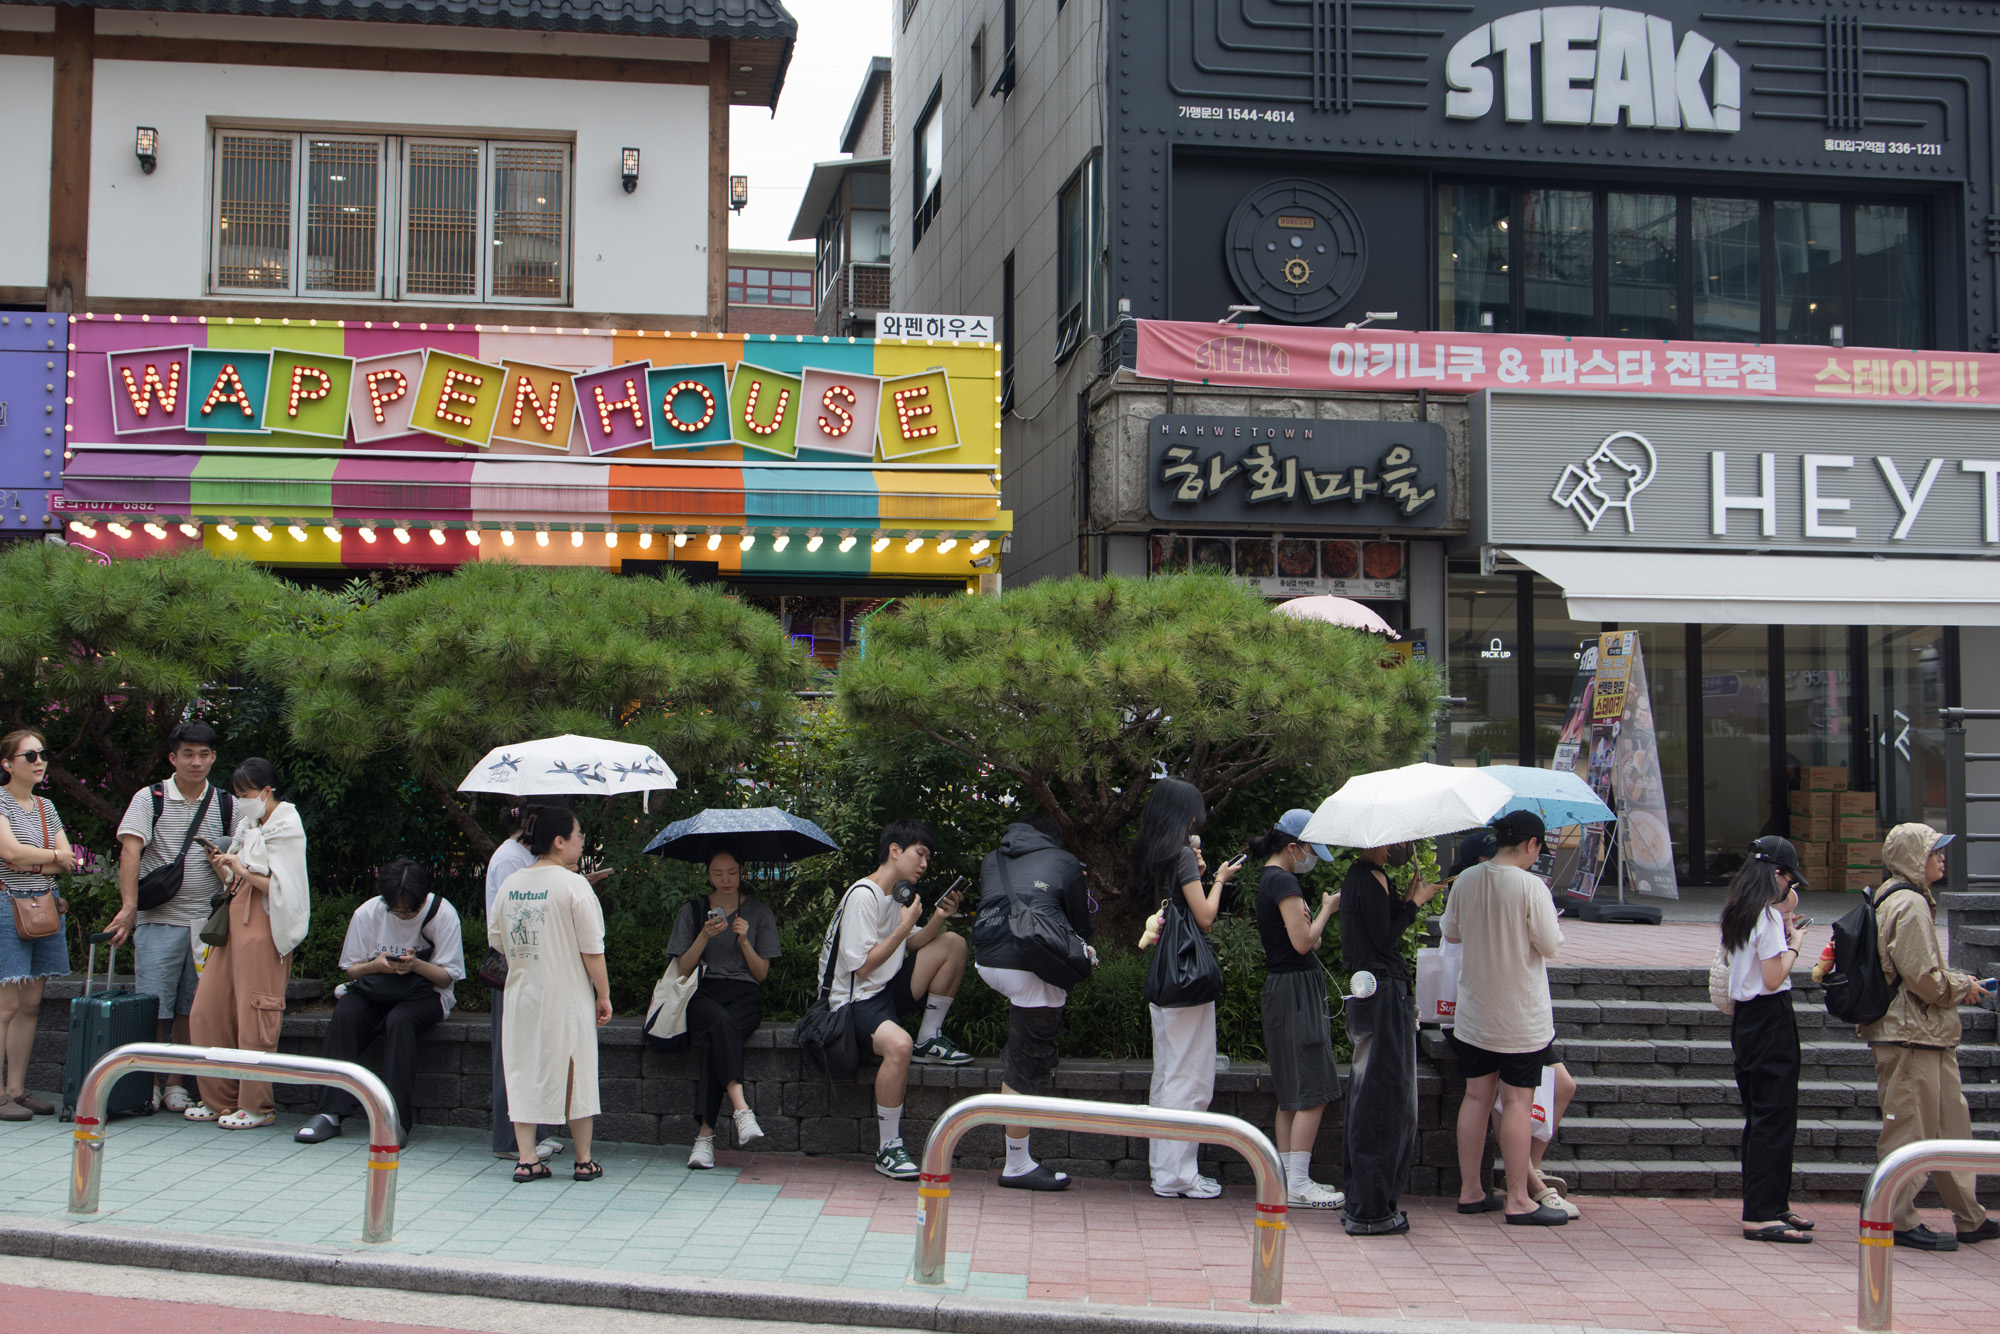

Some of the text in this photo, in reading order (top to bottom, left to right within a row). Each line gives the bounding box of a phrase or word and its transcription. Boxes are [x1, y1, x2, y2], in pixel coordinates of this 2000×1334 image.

[1445, 5, 1741, 133] STEAK!
[1178, 105, 1295, 123] 가맹문의 1544-4614
[1824, 138, 1941, 156] 홍대입구역점 336-1211
[1280, 216, 1313, 226] HONGDAE
[883, 316, 988, 338] 와펜하우스
[1195, 335, 1290, 376] STEAK!
[1328, 342, 1777, 391] 야키니쿠 & 파스타 전문점
[1814, 357, 1980, 398] 스테이키!
[1161, 424, 1313, 440] HAHWETOWN
[1163, 444, 1437, 513] 하회마을
[508, 889, 549, 901] Mutual
[1311, 1200, 1337, 1208] crocs
